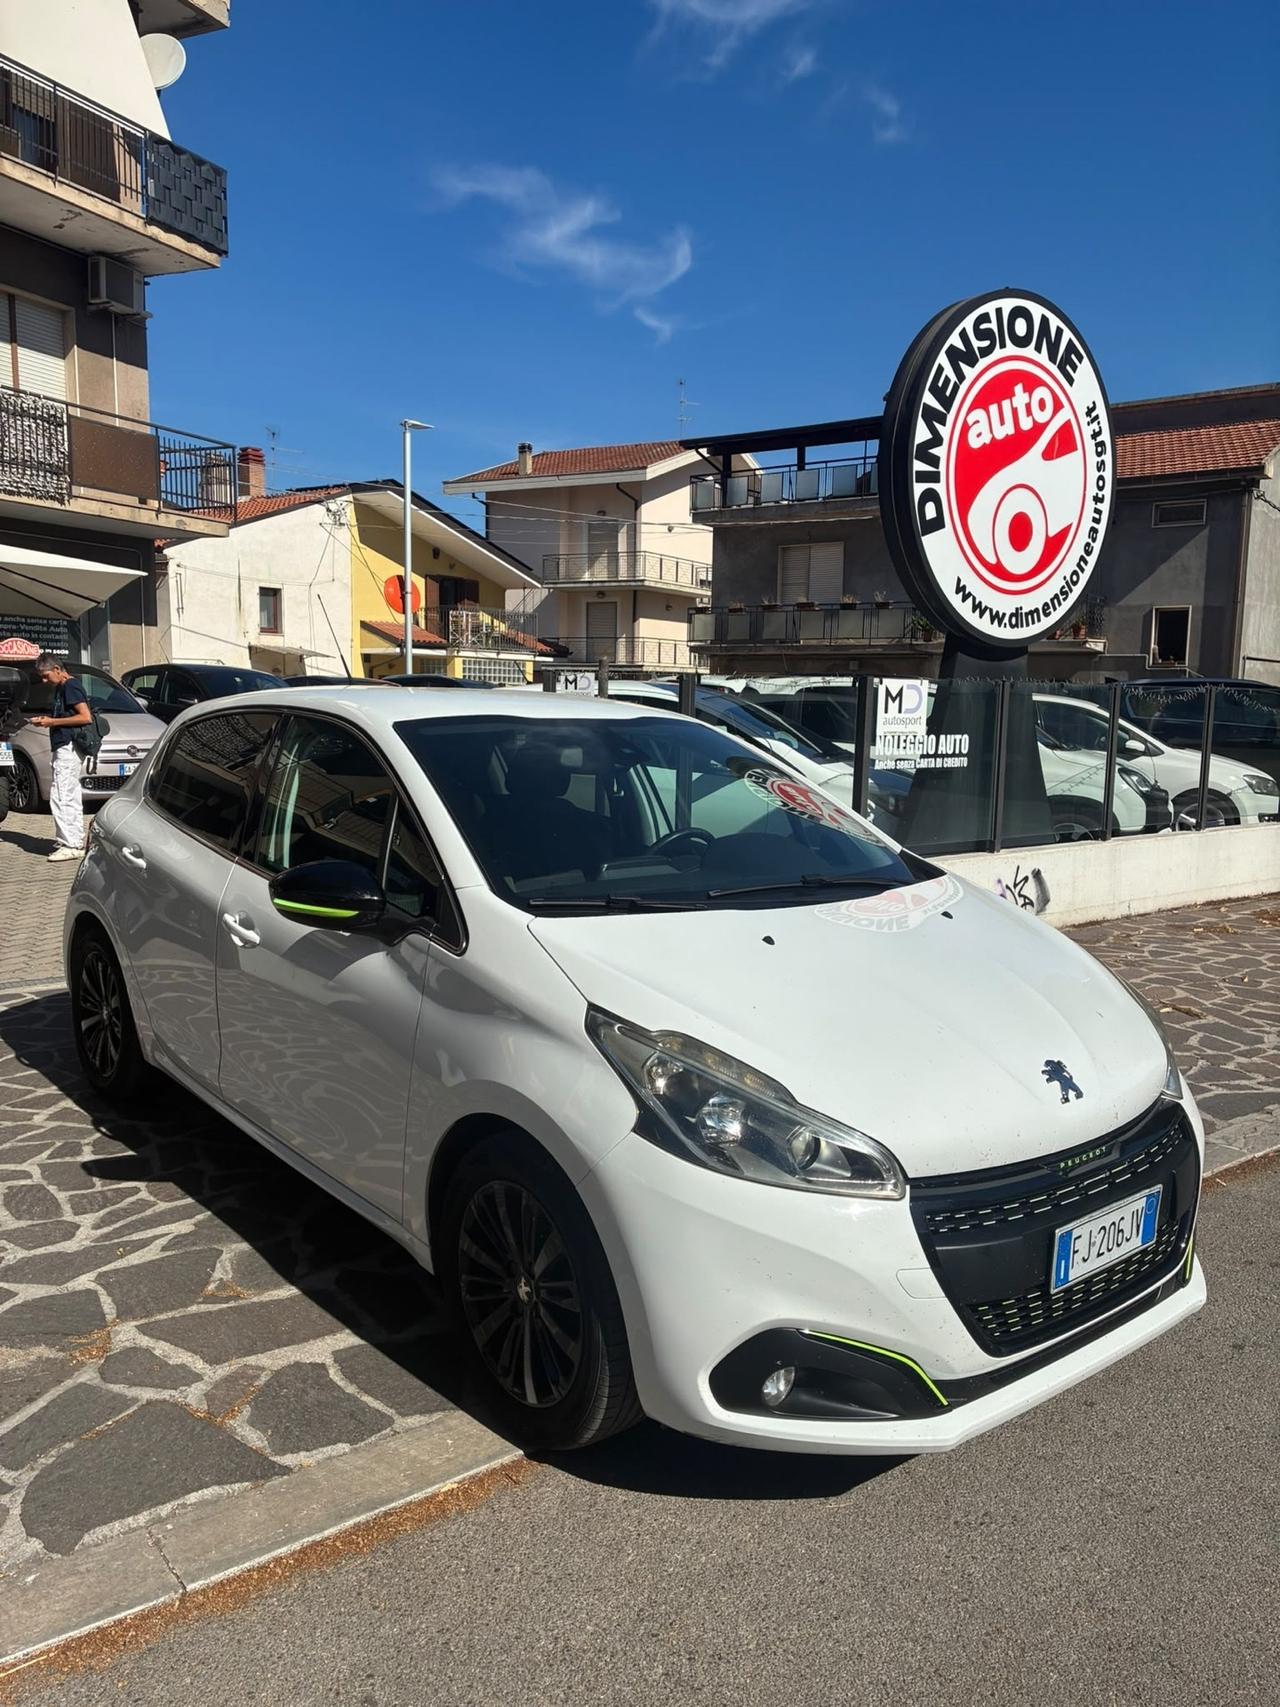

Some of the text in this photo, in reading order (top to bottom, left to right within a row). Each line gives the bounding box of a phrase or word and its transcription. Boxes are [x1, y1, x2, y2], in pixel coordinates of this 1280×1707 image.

[913, 304, 1084, 537] DIMENSIONE
[966, 382, 1055, 450] auto
[954, 400, 1107, 630] www.dimensioneautosgt.it
[884, 684, 923, 715] MD
[882, 716, 922, 729] autosport
[875, 734, 970, 756] NOLEGGIO AUTO
[874, 757, 968, 771] Anche senza CARTA DI CREDITO
[1060, 1146, 1106, 1169] PEUGEOT
